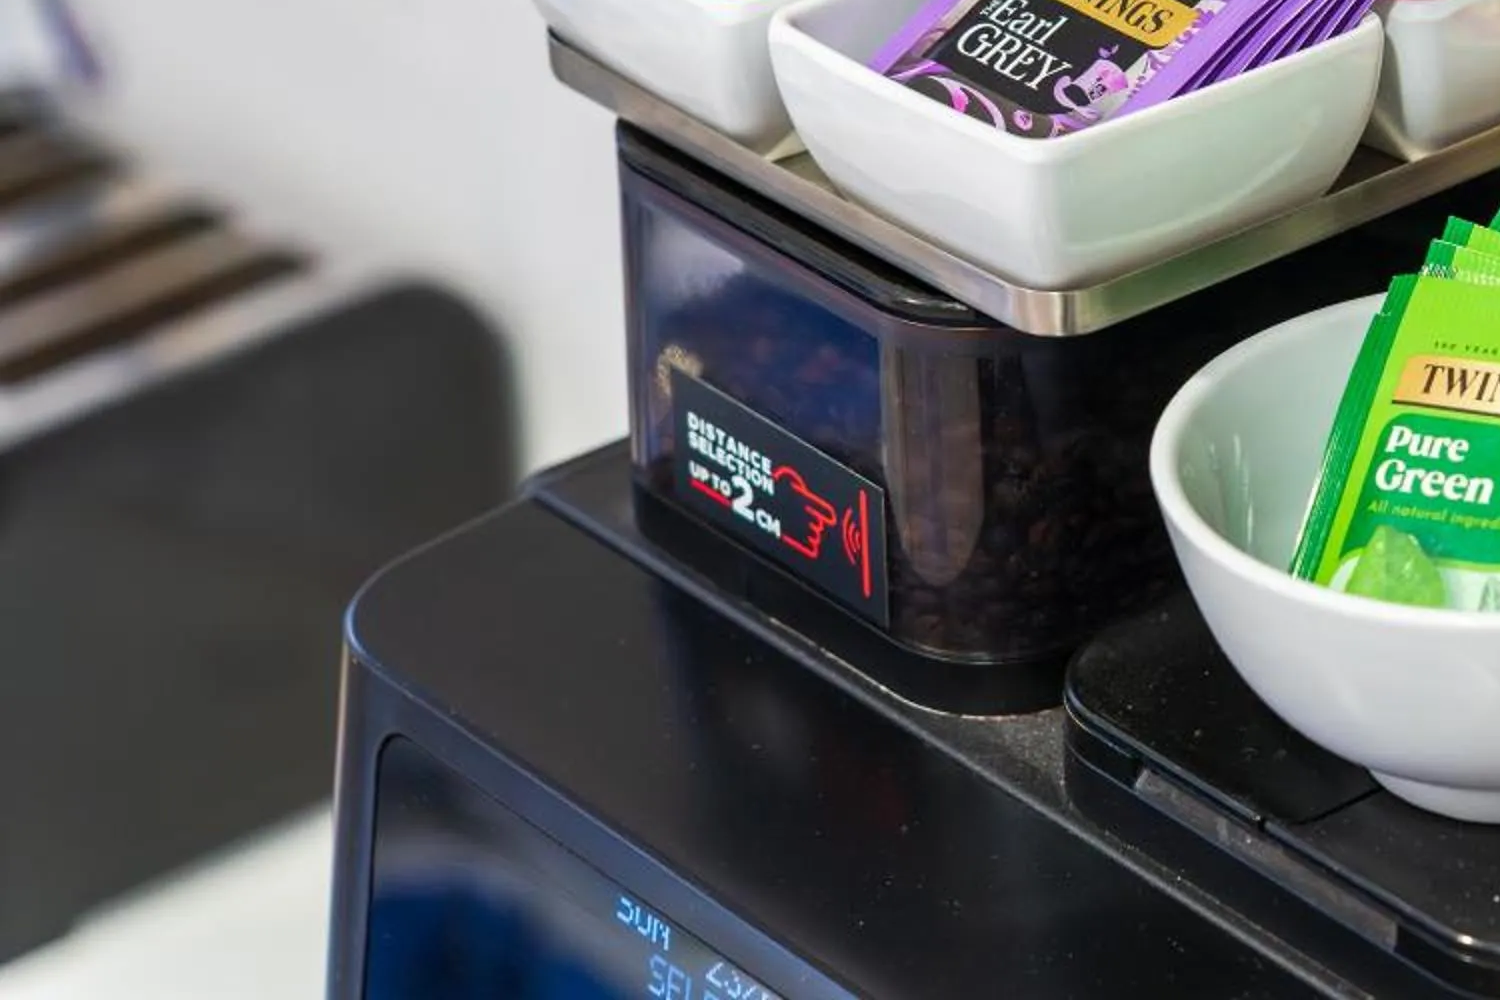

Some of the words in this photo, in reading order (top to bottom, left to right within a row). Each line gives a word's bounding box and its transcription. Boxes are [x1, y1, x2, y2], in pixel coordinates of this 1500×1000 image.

[956, 23, 1073, 91] GREY
[687, 411, 773, 477] DISTANCE
[688, 431, 775, 497] SELECTION
[1384, 425, 1470, 463] Pure
[690, 460, 710, 482] UP
[711, 472, 732, 498] TO
[731, 475, 755, 522] 2
[1375, 459, 1495, 505] Green
